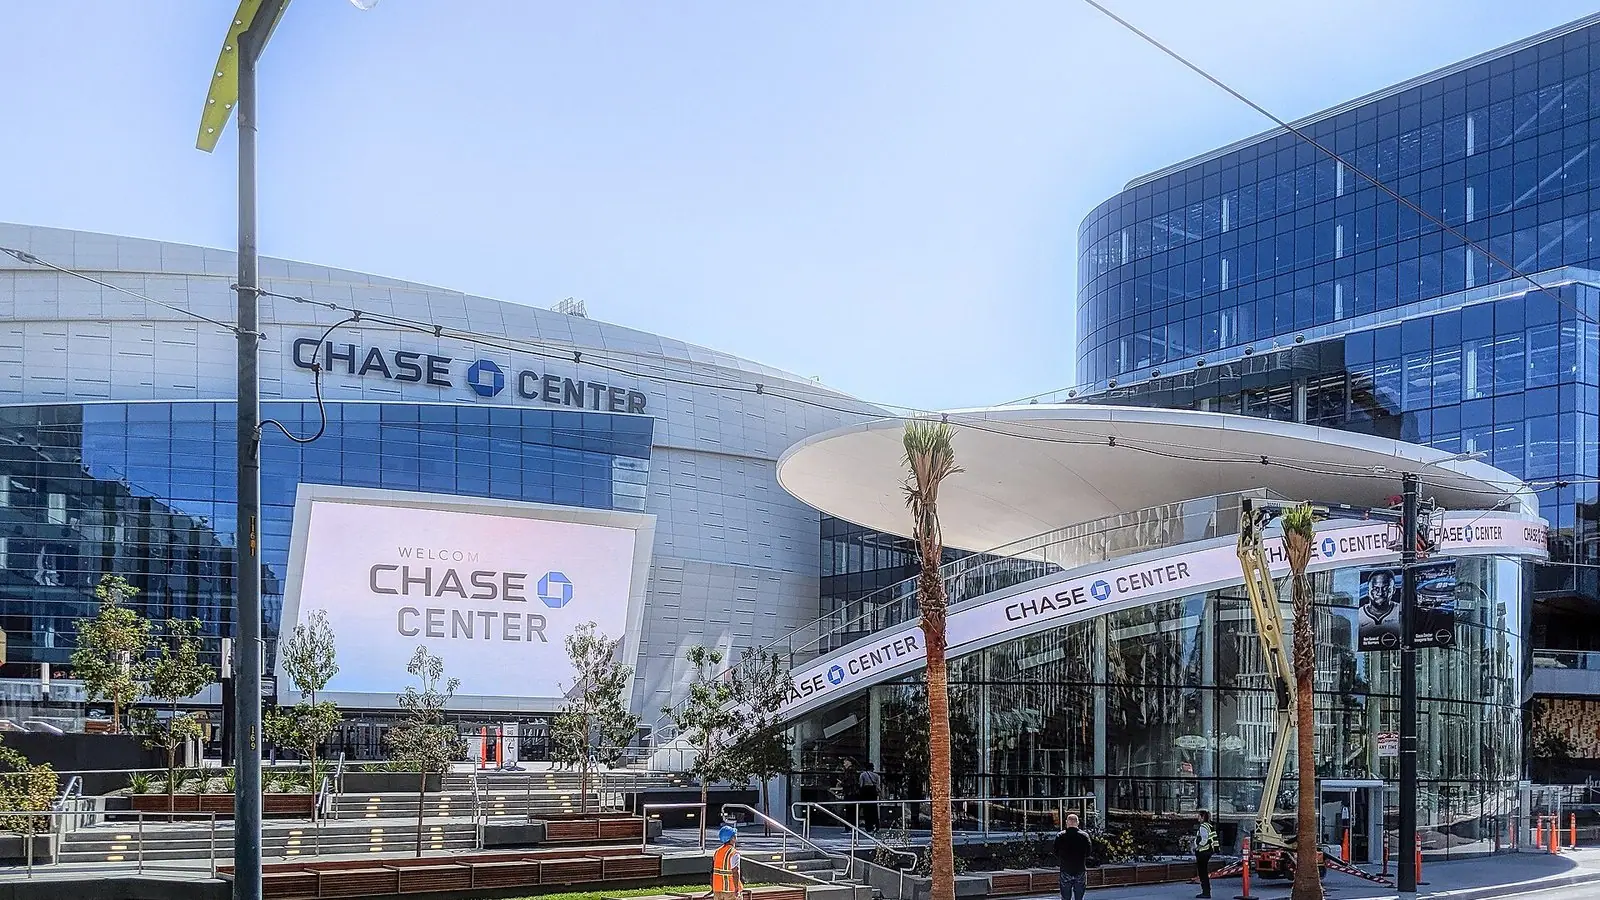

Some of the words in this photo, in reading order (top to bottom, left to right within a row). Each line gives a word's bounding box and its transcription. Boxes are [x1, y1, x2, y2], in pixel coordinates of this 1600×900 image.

[292, 337, 453, 387] CHASE
[518, 369, 647, 415] CENTER
[1339, 532, 1390, 554] CENTER
[1475, 525, 1503, 541] CENTER
[369, 563, 529, 603] CHASE
[1005, 586, 1088, 622] CHASE
[1116, 562, 1191, 594] CENTER
[397, 606, 549, 643] CENTER
[847, 635, 919, 675] CENTER
